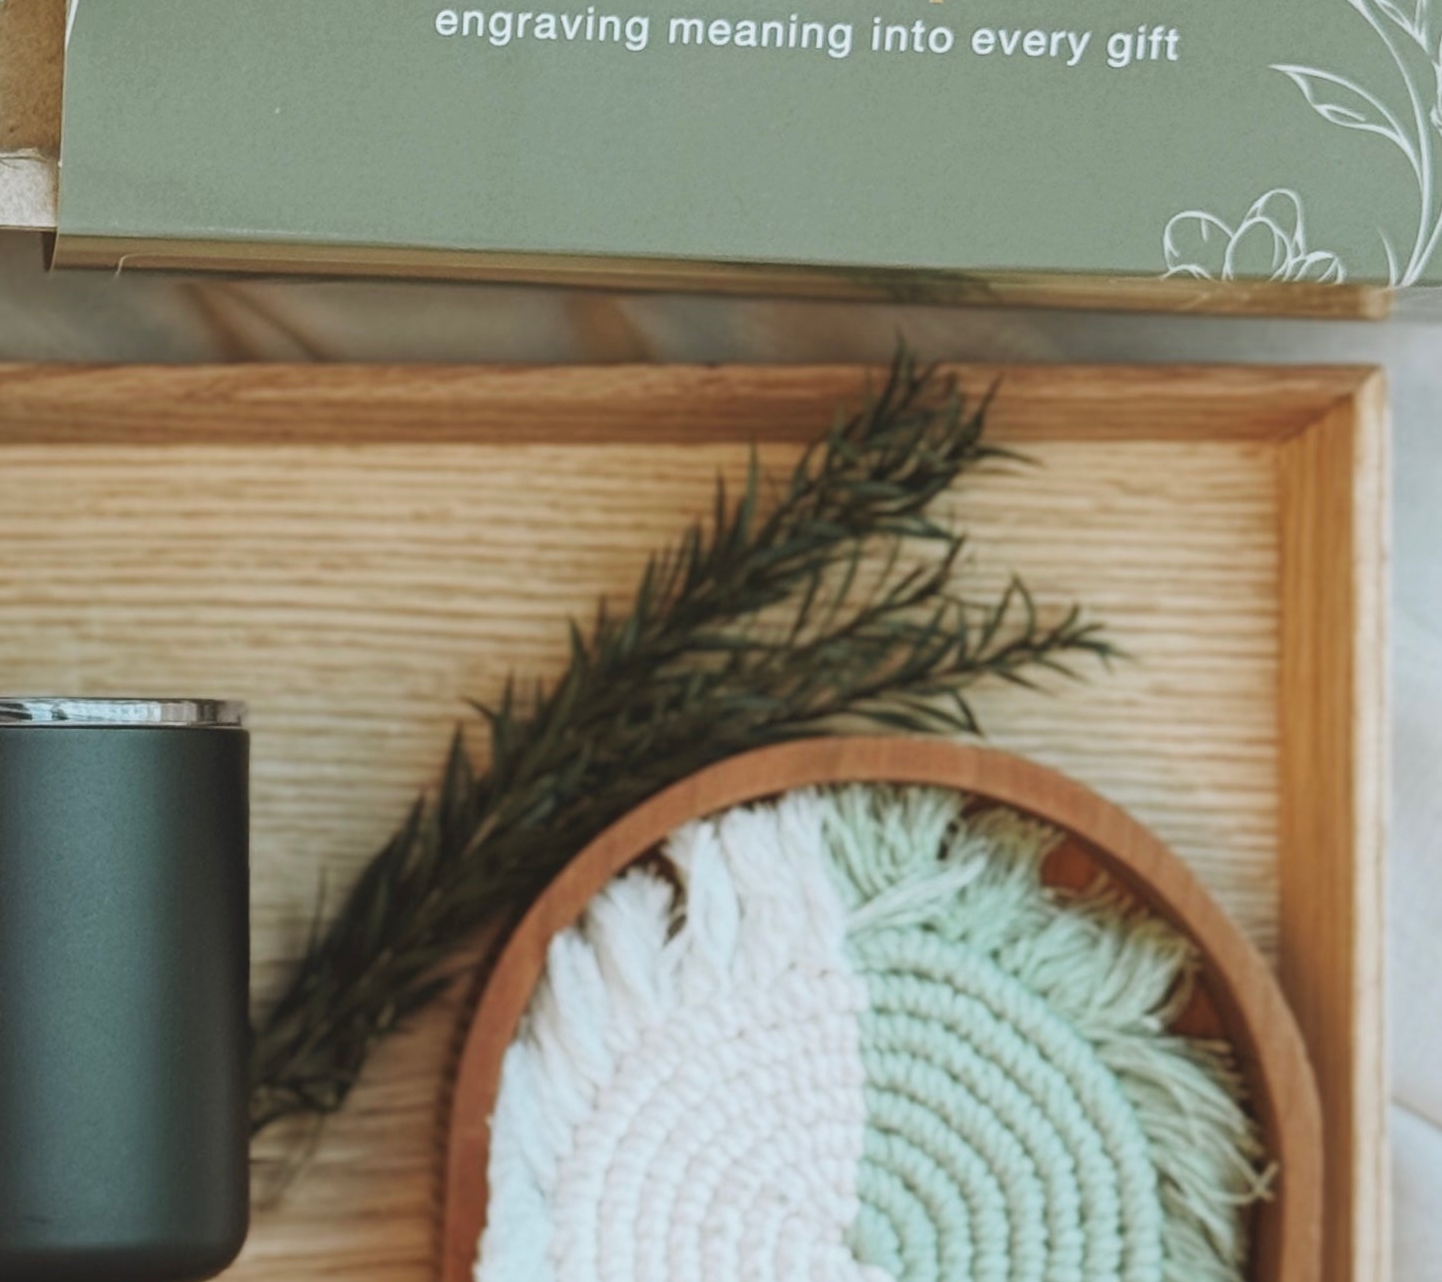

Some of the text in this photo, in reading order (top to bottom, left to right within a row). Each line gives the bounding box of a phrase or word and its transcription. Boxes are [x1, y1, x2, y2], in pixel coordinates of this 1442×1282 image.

[434, 5, 1182, 69] engraving meaning into every gift
